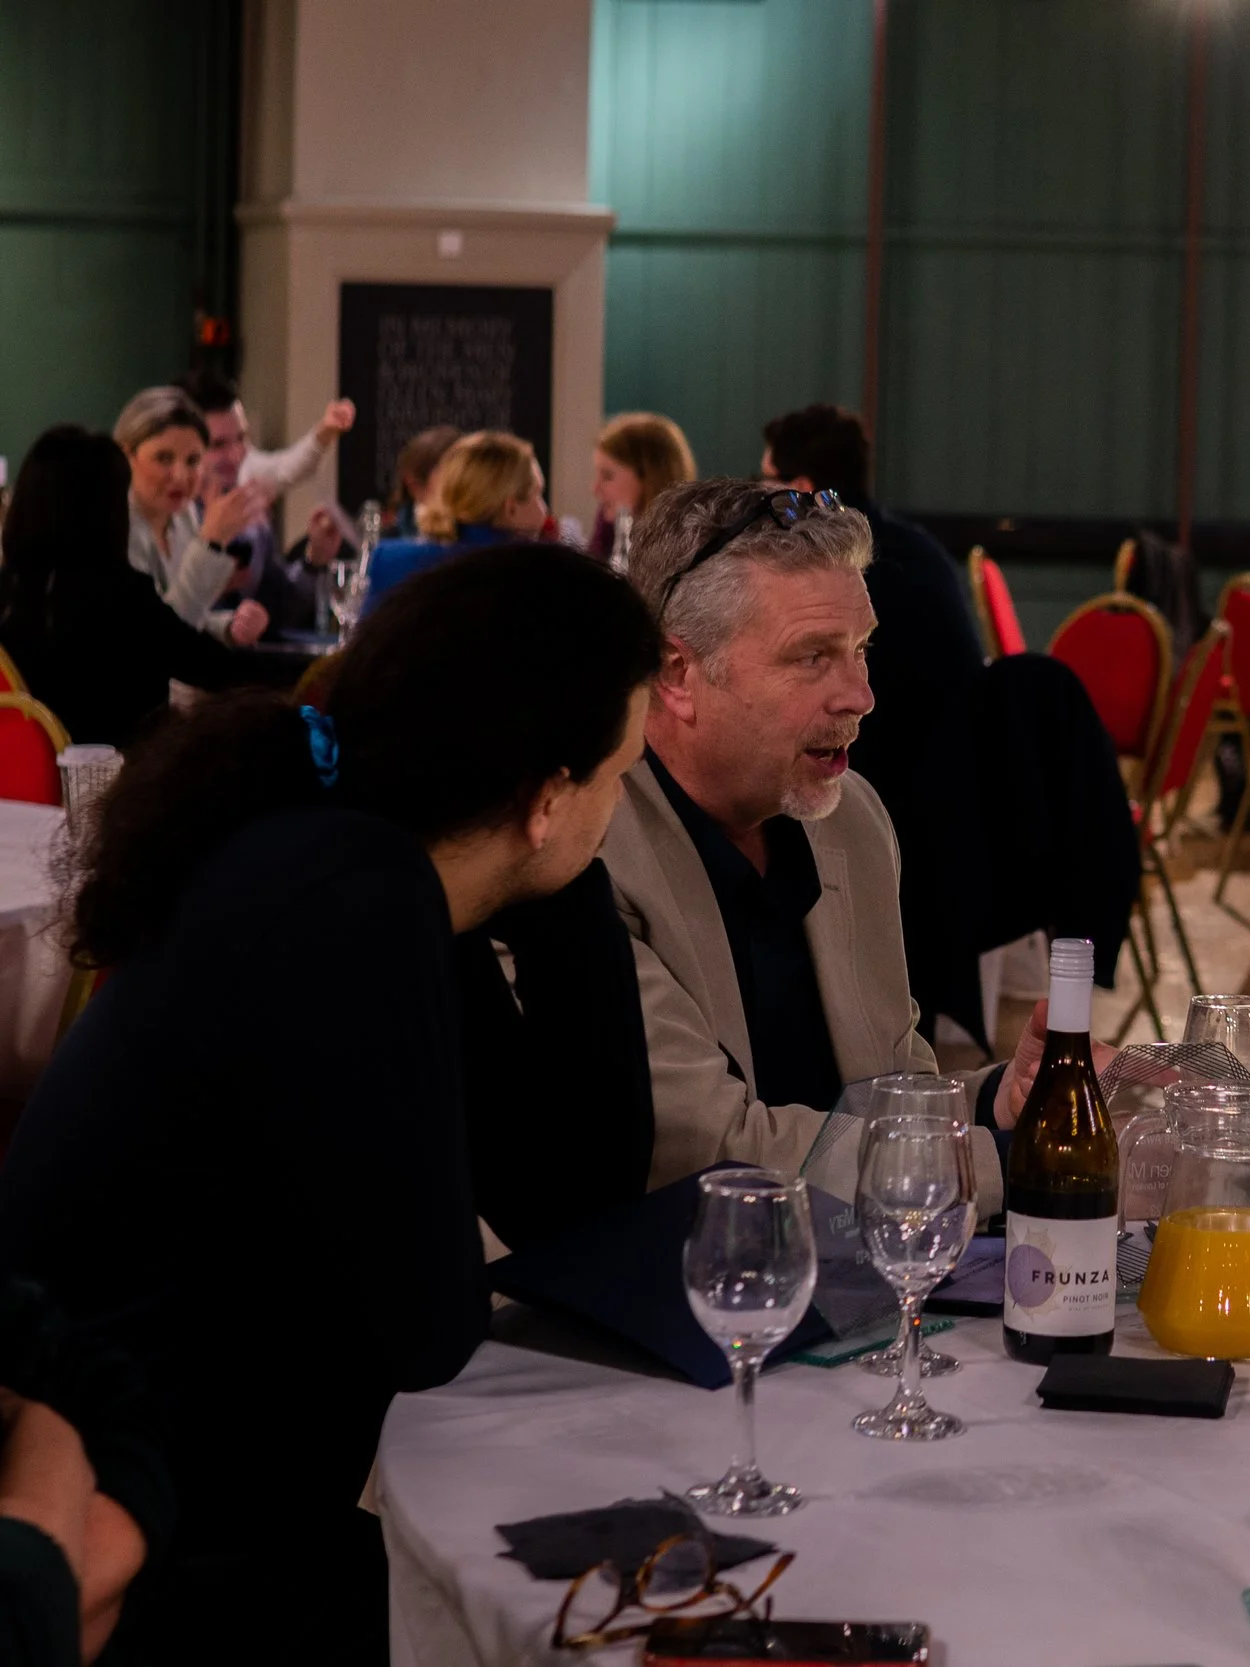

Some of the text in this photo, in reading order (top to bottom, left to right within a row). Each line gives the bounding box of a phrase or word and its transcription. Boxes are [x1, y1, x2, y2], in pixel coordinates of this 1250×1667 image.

[1032, 1269, 1110, 1286] FRUNZA
[1063, 1291, 1110, 1304] PINOT NOIR
